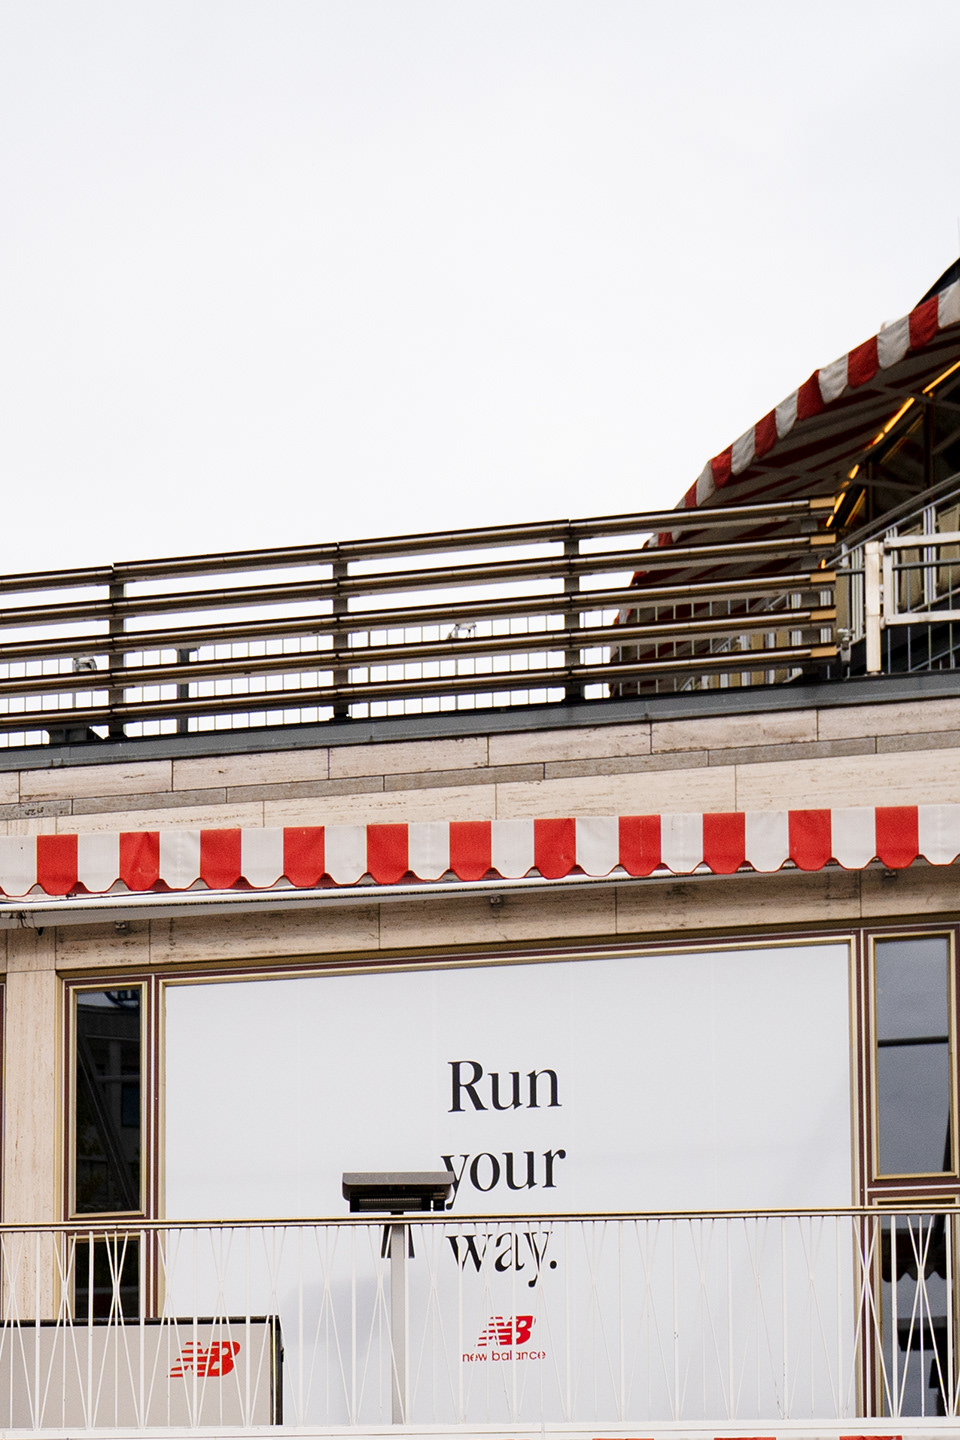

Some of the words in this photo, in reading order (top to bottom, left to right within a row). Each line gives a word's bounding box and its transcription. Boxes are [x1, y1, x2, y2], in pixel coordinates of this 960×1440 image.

[447, 1060, 563, 1113] Run
[440, 1149, 567, 1211] your
[444, 1230, 558, 1288] way.
[461, 1352, 488, 1363] new
[491, 1349, 547, 1361] balance
